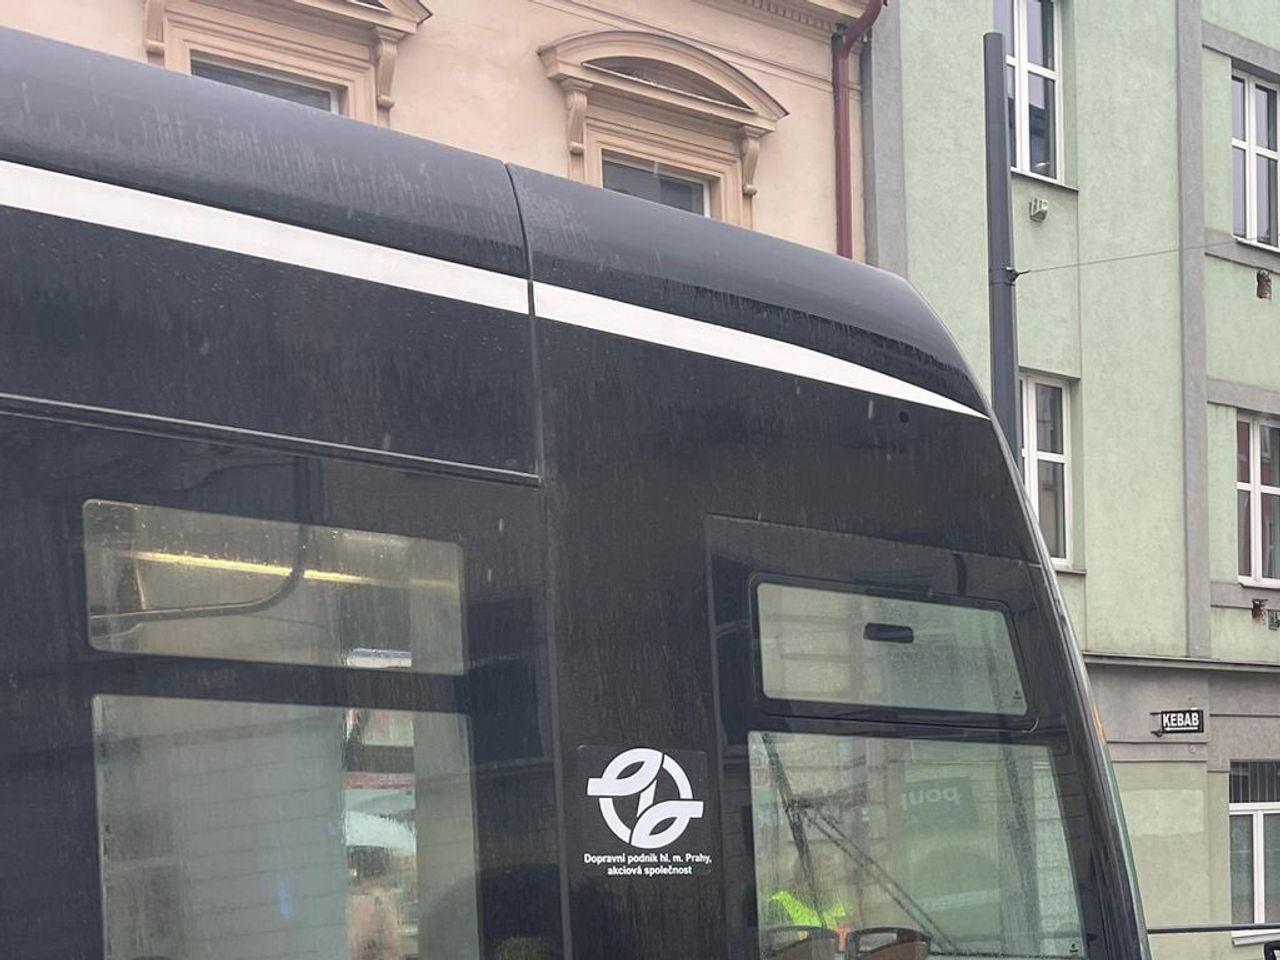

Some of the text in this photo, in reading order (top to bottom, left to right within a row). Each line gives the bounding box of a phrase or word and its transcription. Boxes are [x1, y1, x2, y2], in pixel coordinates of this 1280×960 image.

[1162, 712, 1200, 728] KEBAB
[583, 852, 712, 865] Dopravní podnik hl. m. Prahy,
[607, 865, 693, 877] akciová společnost
